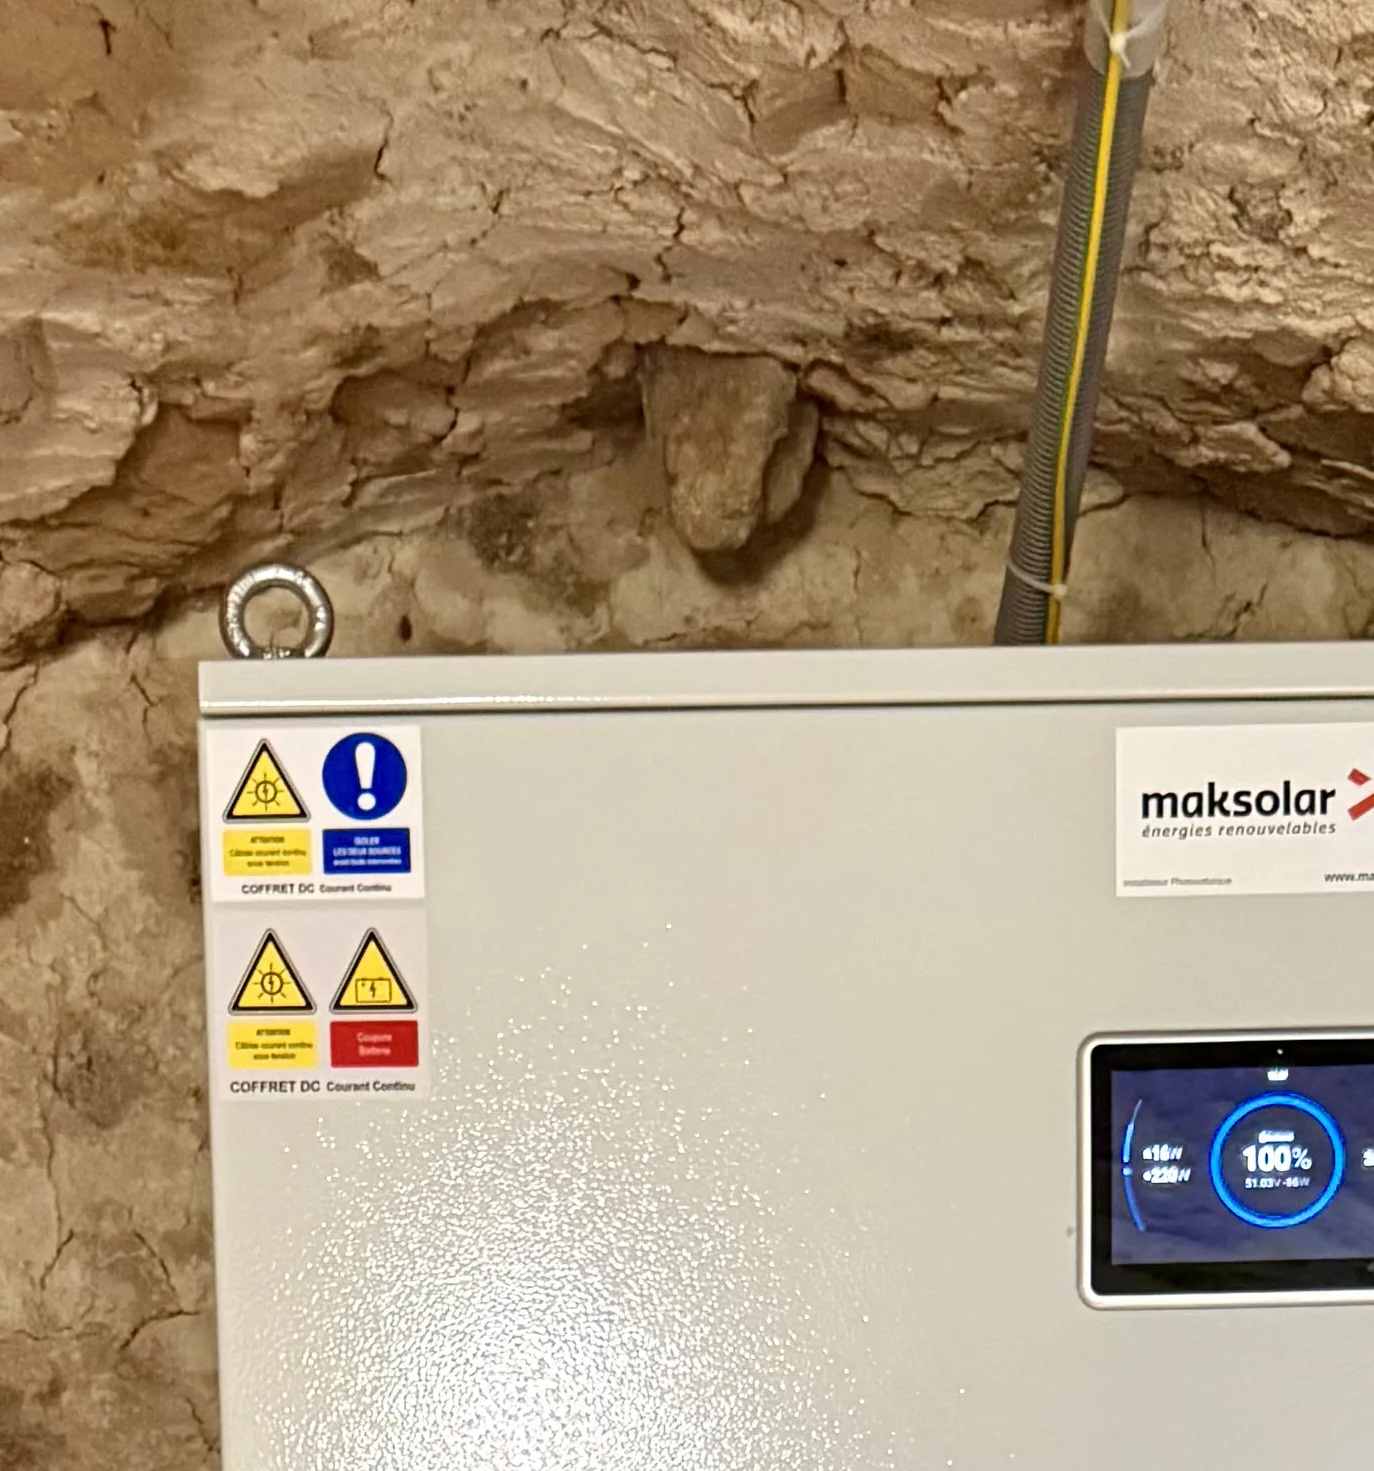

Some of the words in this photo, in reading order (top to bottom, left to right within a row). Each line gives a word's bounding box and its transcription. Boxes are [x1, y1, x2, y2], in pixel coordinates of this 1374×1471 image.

[1141, 780, 1337, 819] maksolar
[1142, 824, 1212, 840] énergies
[1218, 821, 1337, 838] renouvelables
[241, 883, 295, 895] COFFRET
[229, 1081, 296, 1094] COFFRET
[300, 1080, 321, 1093] DC
[326, 1080, 371, 1092] Courant
[372, 1080, 416, 1092] Continu
[1241, 1144, 1313, 1173] 100%
